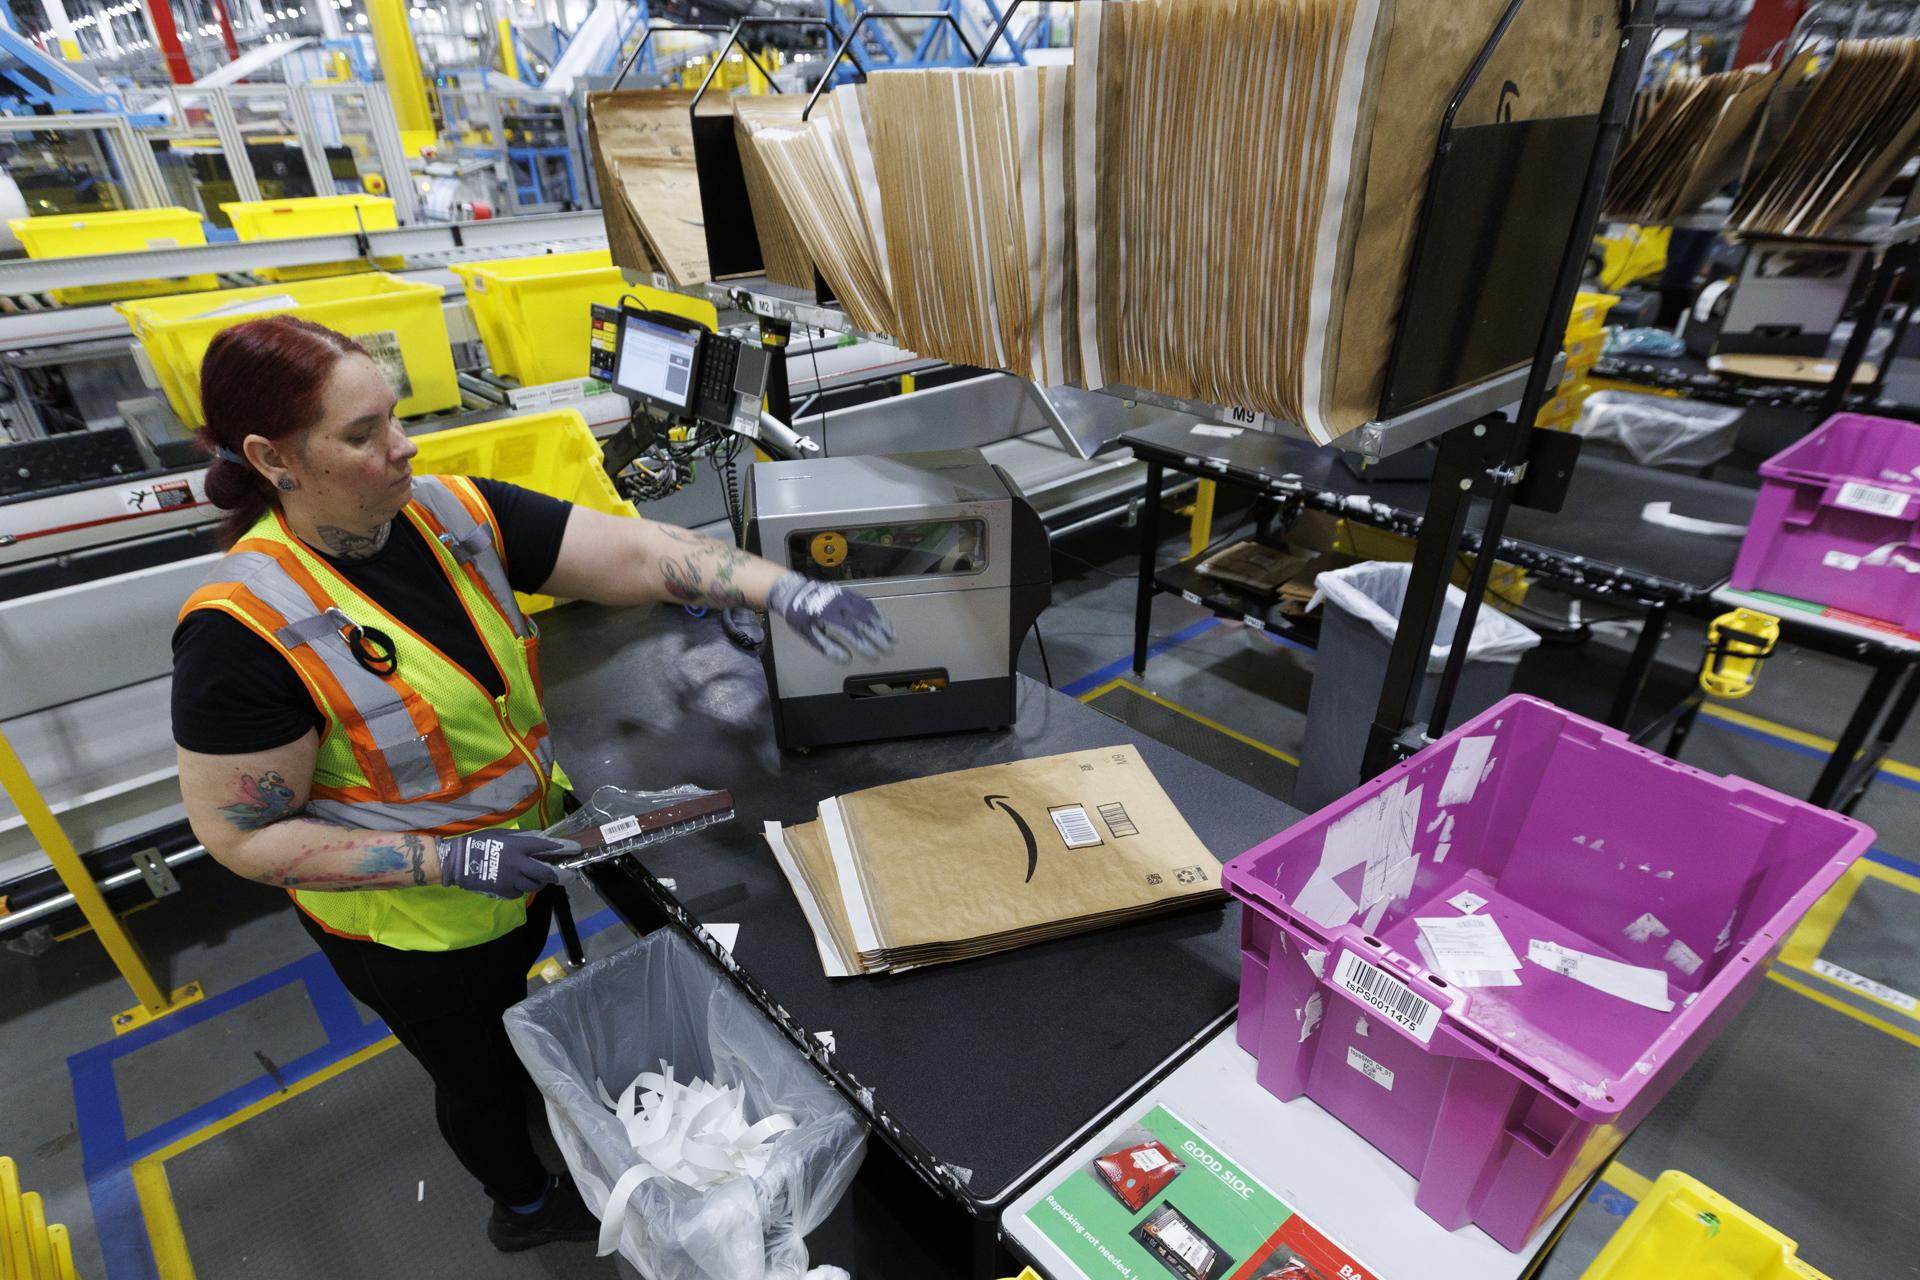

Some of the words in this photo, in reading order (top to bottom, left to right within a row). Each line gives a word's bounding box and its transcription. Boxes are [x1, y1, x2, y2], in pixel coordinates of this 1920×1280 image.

[760, 300, 770, 312] M2
[1233, 406, 1255, 424] M9
[488, 840, 504, 883] FASTENAL
[1346, 980, 1417, 1031] tsPS0011475
[1184, 1140, 1222, 1172] GOOD
[1221, 1170, 1255, 1198] SIOC
[1046, 1195, 1085, 1234] Repacking
[1083, 1231, 1100, 1247] not
[1097, 1245, 1131, 1279] needed,
